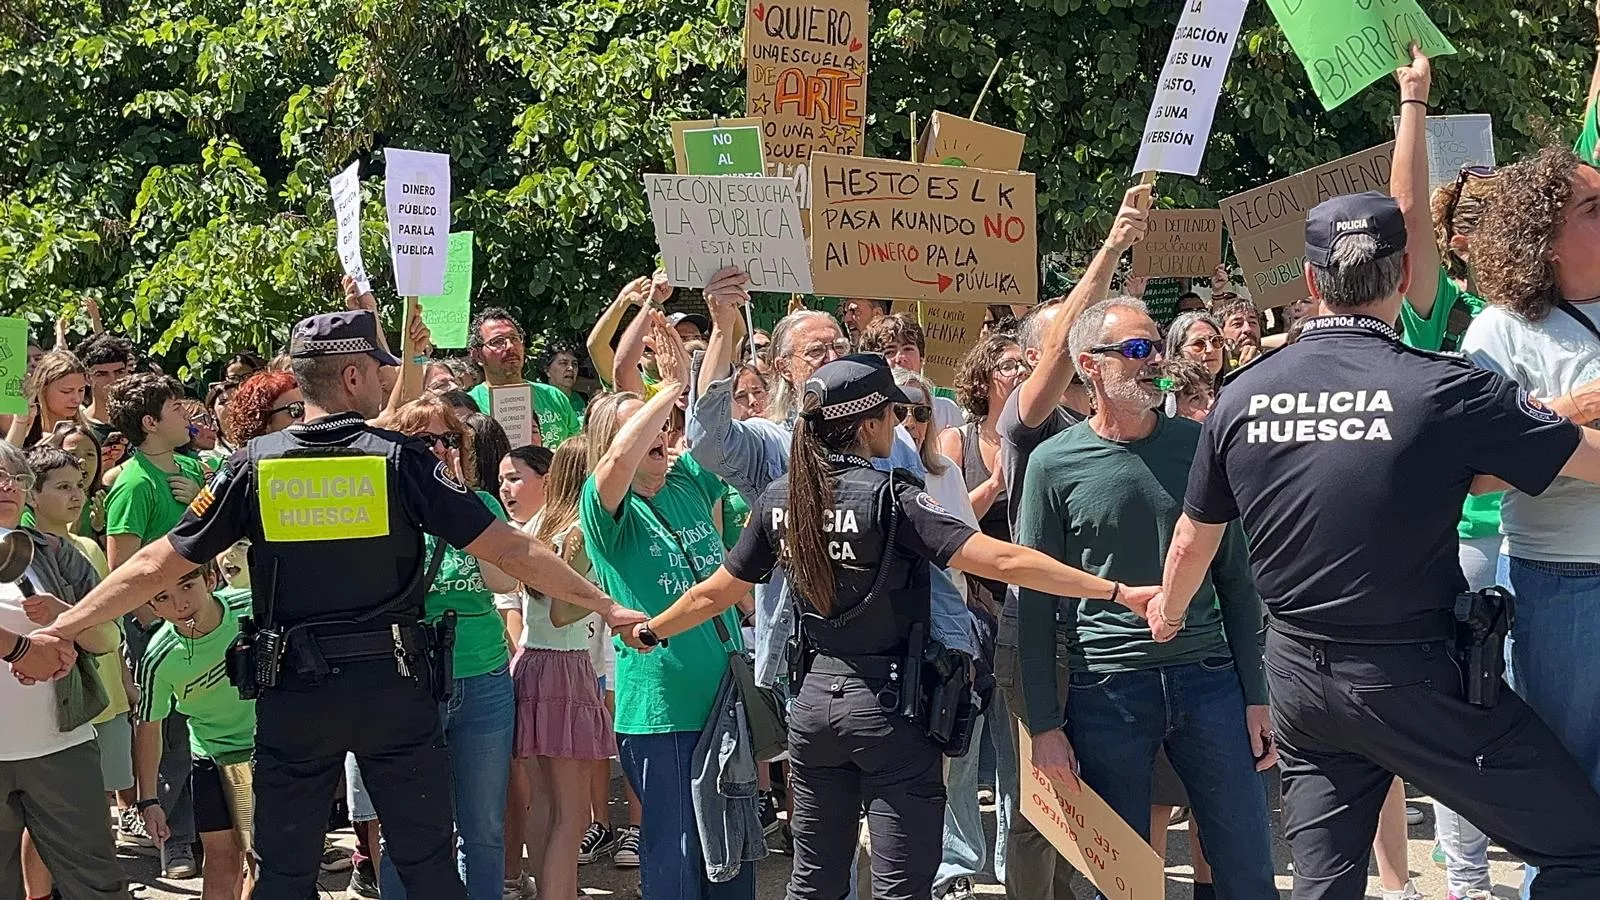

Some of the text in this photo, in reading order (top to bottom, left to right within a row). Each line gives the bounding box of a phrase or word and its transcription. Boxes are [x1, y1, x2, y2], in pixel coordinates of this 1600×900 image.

[765, 5, 851, 46] QUIERO
[1191, 55, 1212, 69] UN
[752, 63, 862, 127] DE ARTE
[1164, 105, 1188, 119] UNA
[712, 133, 732, 146] NO
[783, 122, 814, 140] UNA
[717, 152, 734, 166] AL
[823, 165, 919, 199] HESTO
[927, 177, 958, 200] ES
[971, 179, 986, 203] L
[998, 182, 1015, 210] K
[1315, 149, 1394, 203] ATIEND
[402, 184, 436, 196] DINERO
[728, 184, 794, 204] ESCUCHA
[398, 201, 437, 216] PÚBLICO
[398, 224, 435, 236] PARA LA
[665, 207, 696, 236] LA
[821, 207, 1026, 243] PASA KUANDO NO
[1336, 218, 1368, 232] POLICIA
[397, 243, 434, 256] PÚBLICA
[701, 237, 762, 255] ESTÁ EN
[858, 240, 919, 267] DINERO
[926, 244, 949, 268] PA
[954, 247, 979, 267] LA
[1253, 238, 1286, 263] LA
[674, 256, 703, 282] LA
[955, 267, 1021, 295] PÚVLIKA
[925, 322, 967, 345] PENSAR
[1248, 390, 1394, 416] POLICIA
[1247, 418, 1393, 444] HUESCA
[270, 475, 376, 501] POLICIA
[279, 506, 371, 528] HUESCA
[1032, 793, 1078, 843] QUIERO
[1093, 828, 1120, 861] SER
[1085, 847, 1105, 870] NO
